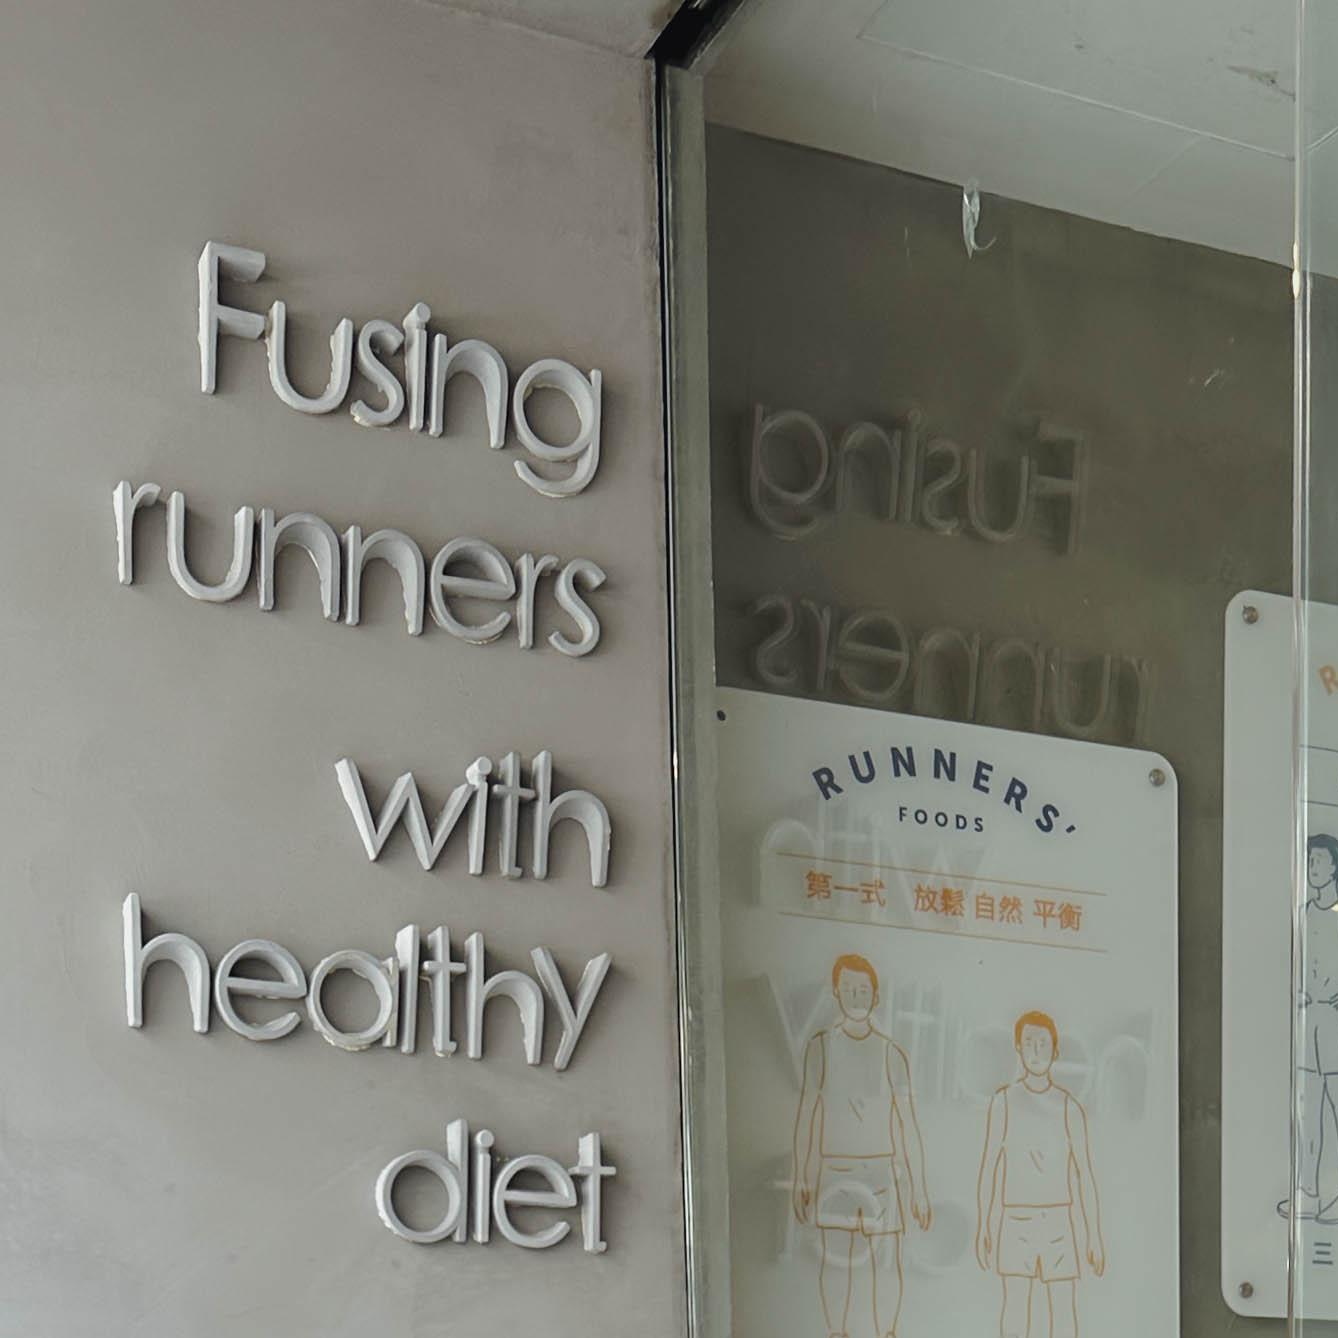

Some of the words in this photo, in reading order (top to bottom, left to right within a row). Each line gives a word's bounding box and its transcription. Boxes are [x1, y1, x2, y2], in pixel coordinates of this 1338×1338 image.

[198, 240, 603, 496] Fusing
[113, 479, 607, 657] runners
[335, 750, 613, 888] with
[898, 806, 985, 834] FOODS
[804, 869, 887, 908] 第一式
[913, 884, 966, 919] 放鬆
[974, 893, 1025, 926] 自然
[1033, 898, 1084, 933] 平衡
[122, 892, 613, 1072] healthy
[376, 1119, 618, 1253] diet
